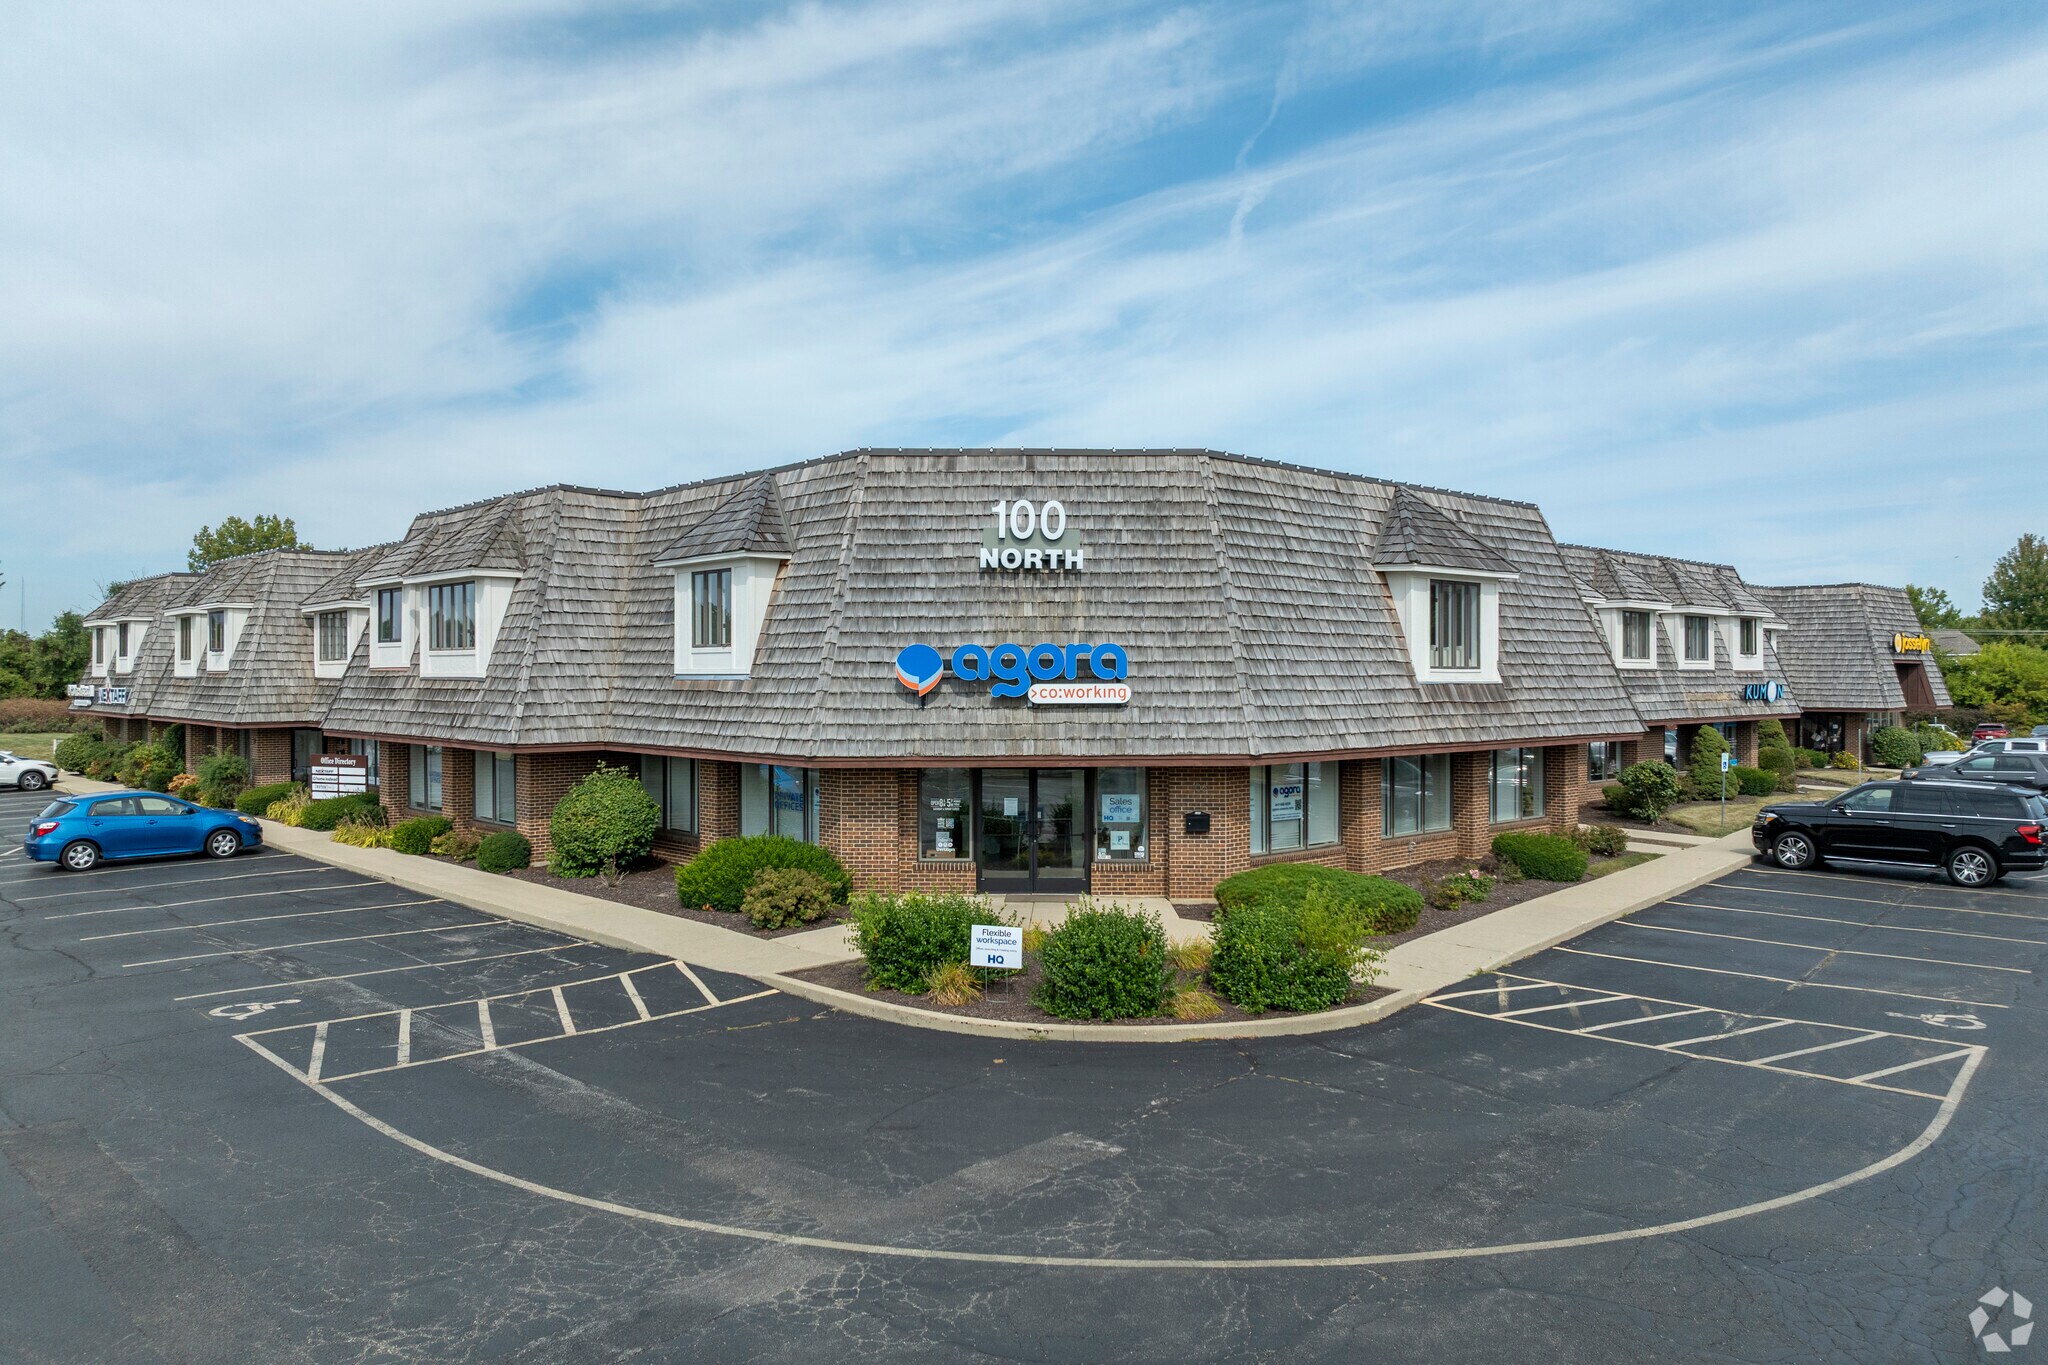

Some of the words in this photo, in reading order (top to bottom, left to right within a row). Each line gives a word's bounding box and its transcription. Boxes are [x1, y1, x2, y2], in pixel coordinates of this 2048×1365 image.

[991, 499, 1066, 540] 100
[980, 548, 1083, 569] NORTH
[952, 643, 1128, 697] agora
[98, 687, 127, 704] NEXTAFF
[1746, 681, 1784, 703] KUMON
[335, 758, 356, 766] Directory
[1280, 786, 1300, 797] agora
[775, 792, 803, 802] PRIVATE
[1109, 797, 1133, 806] Sales
[775, 801, 803, 811] OFFICES
[1109, 805, 1133, 813] office
[982, 929, 1011, 937] Flexible
[976, 937, 1017, 946] workspace
[988, 955, 1004, 964] HQ
